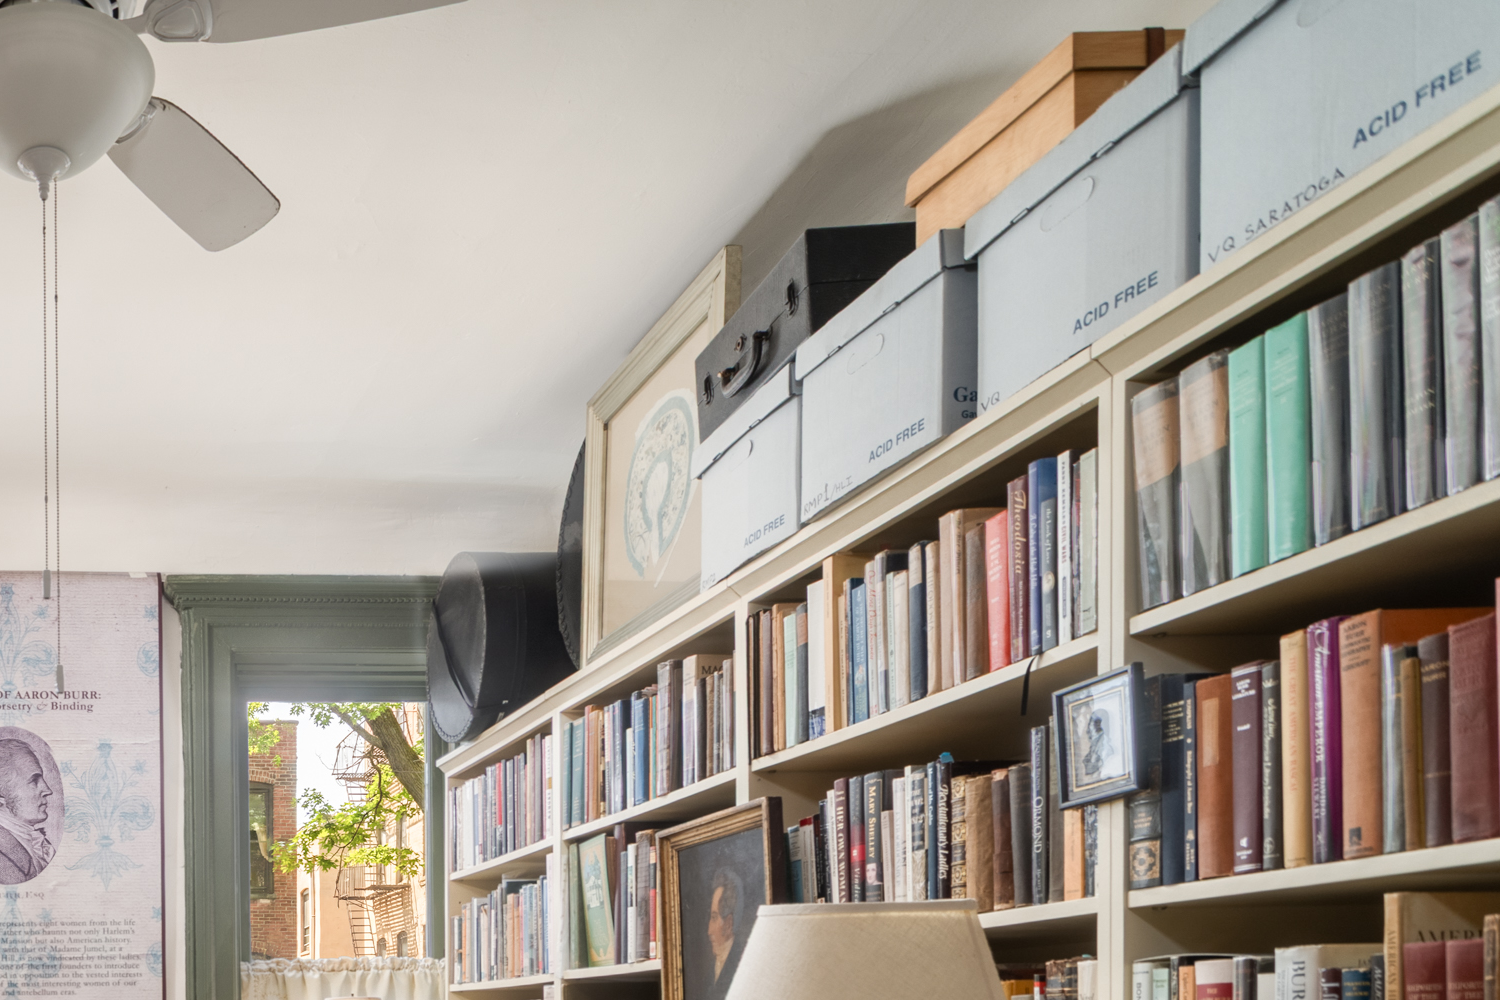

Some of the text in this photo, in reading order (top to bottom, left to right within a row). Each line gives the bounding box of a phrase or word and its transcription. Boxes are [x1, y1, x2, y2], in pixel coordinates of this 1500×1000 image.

[1353, 50, 1482, 149] ACID FREE
[1207, 167, 1345, 263] VQ SARATOGA
[1072, 270, 1158, 335] ACID FREE
[980, 391, 1000, 413] VQ
[869, 418, 925, 463] ACID FREE
[744, 514, 785, 548] ACID FREE
[1013, 490, 1027, 574] Theodosia
[1289, 656, 1297, 674] THE
[1422, 672, 1447, 683] BURR
[15, 690, 60, 700] AARON
[63, 691, 102, 700] BURR:
[36, 701, 48, 711] &
[50, 701, 94, 713] Binding
[1289, 677, 1297, 708] GREAT
[1313, 629, 1330, 762] American EMPEROR
[1289, 711, 1297, 757] AMERICAN
[868, 786, 876, 814] MARY
[836, 806, 844, 830] HER
[939, 850, 948, 880] Ladies
[84, 927, 100, 937] only
[123, 918, 136, 926] life
[66, 936, 103, 944] American
[105, 936, 132, 946] history.
[1388, 929, 1397, 986] AMERICAN
